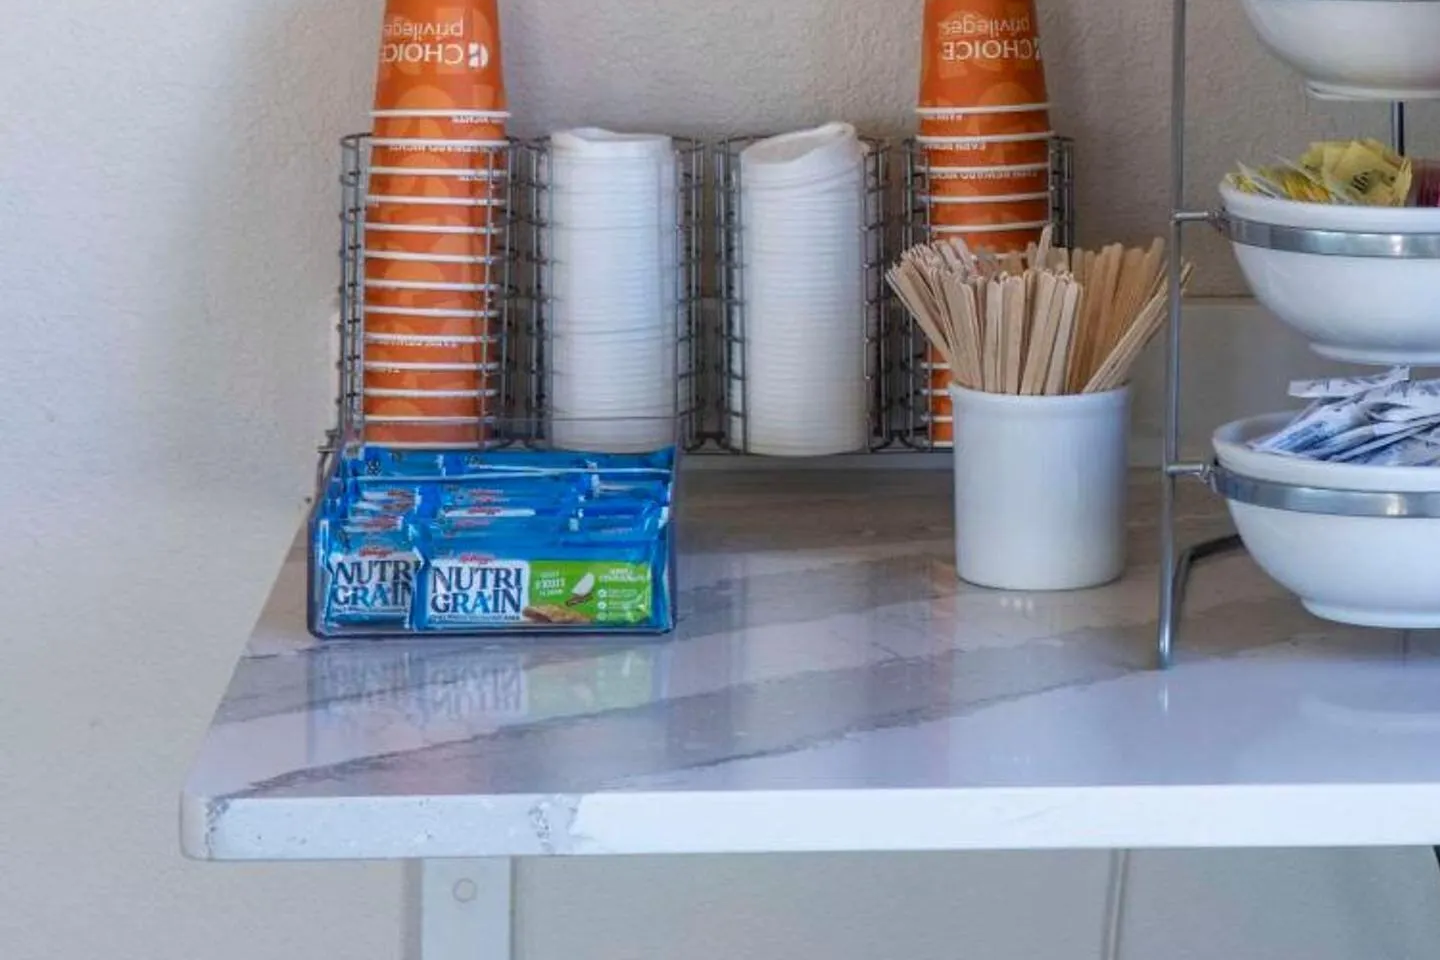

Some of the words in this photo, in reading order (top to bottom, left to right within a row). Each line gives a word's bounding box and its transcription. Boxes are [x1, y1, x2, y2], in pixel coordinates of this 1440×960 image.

[382, 19, 464, 41] privilege
[942, 39, 1033, 61] CHOICE
[431, 566, 523, 594] NUTRI
[430, 588, 523, 614] GRAIN
